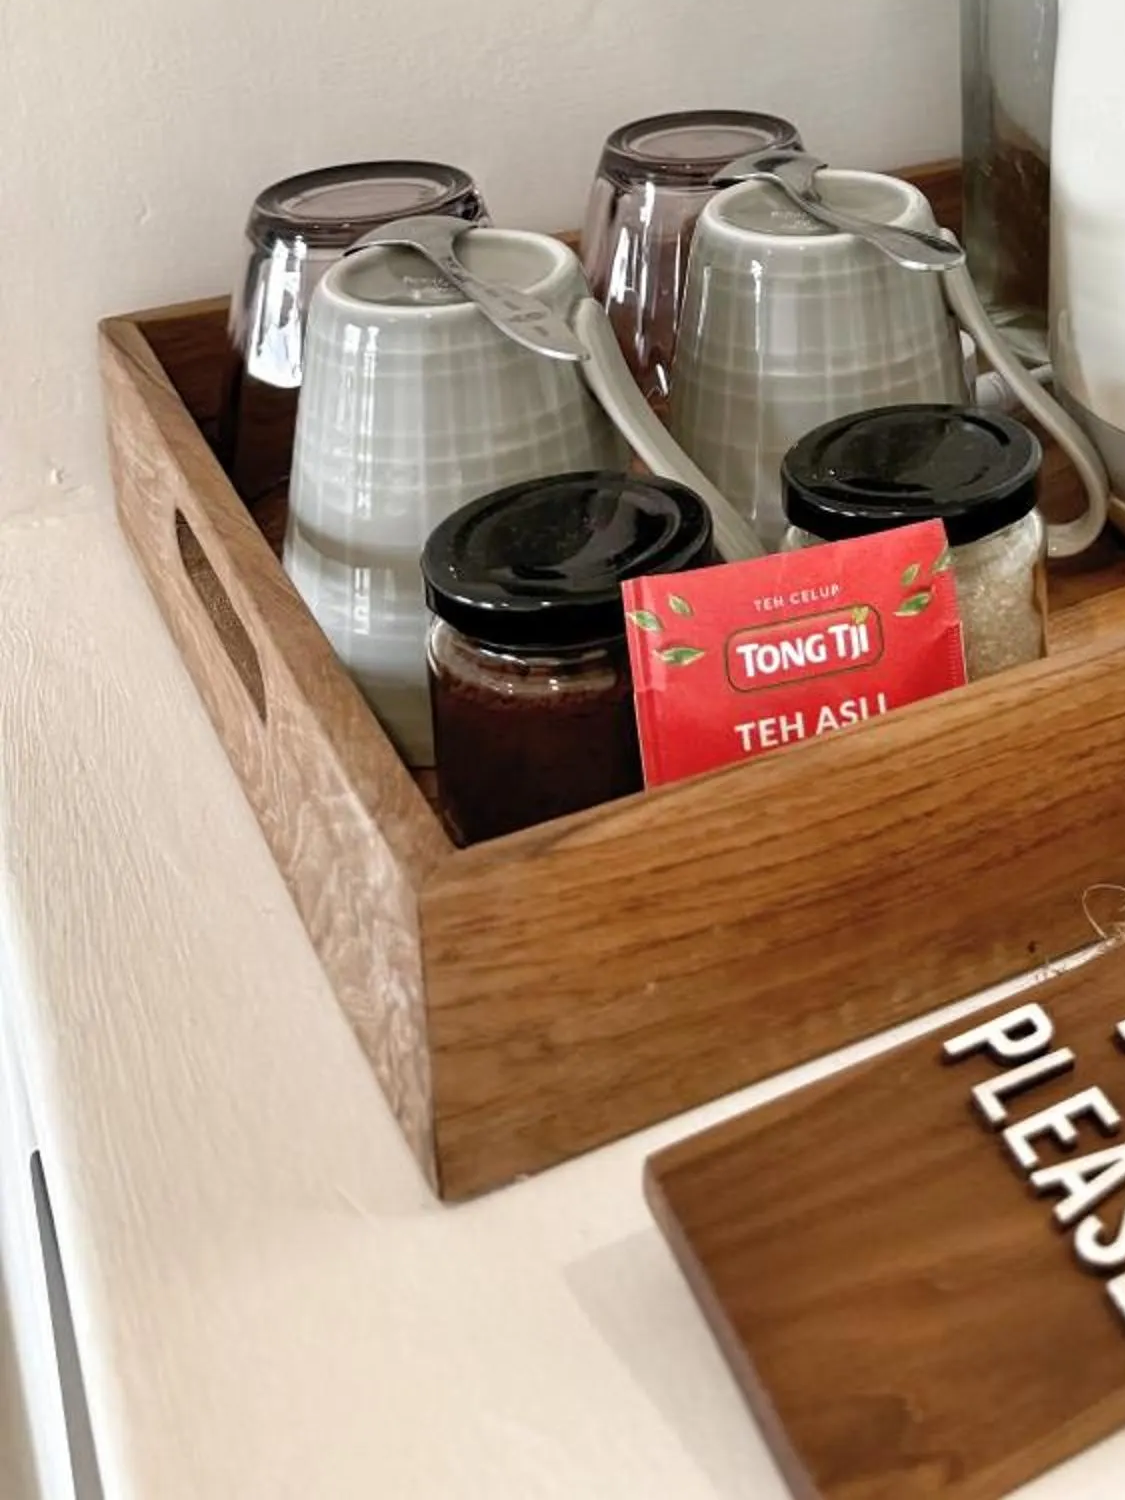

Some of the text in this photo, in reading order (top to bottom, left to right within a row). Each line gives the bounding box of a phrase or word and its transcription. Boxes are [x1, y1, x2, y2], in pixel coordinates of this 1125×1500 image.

[753, 583, 841, 612] TEH CELUP
[735, 632, 828, 678] TONG
[733, 711, 805, 752] TEH
